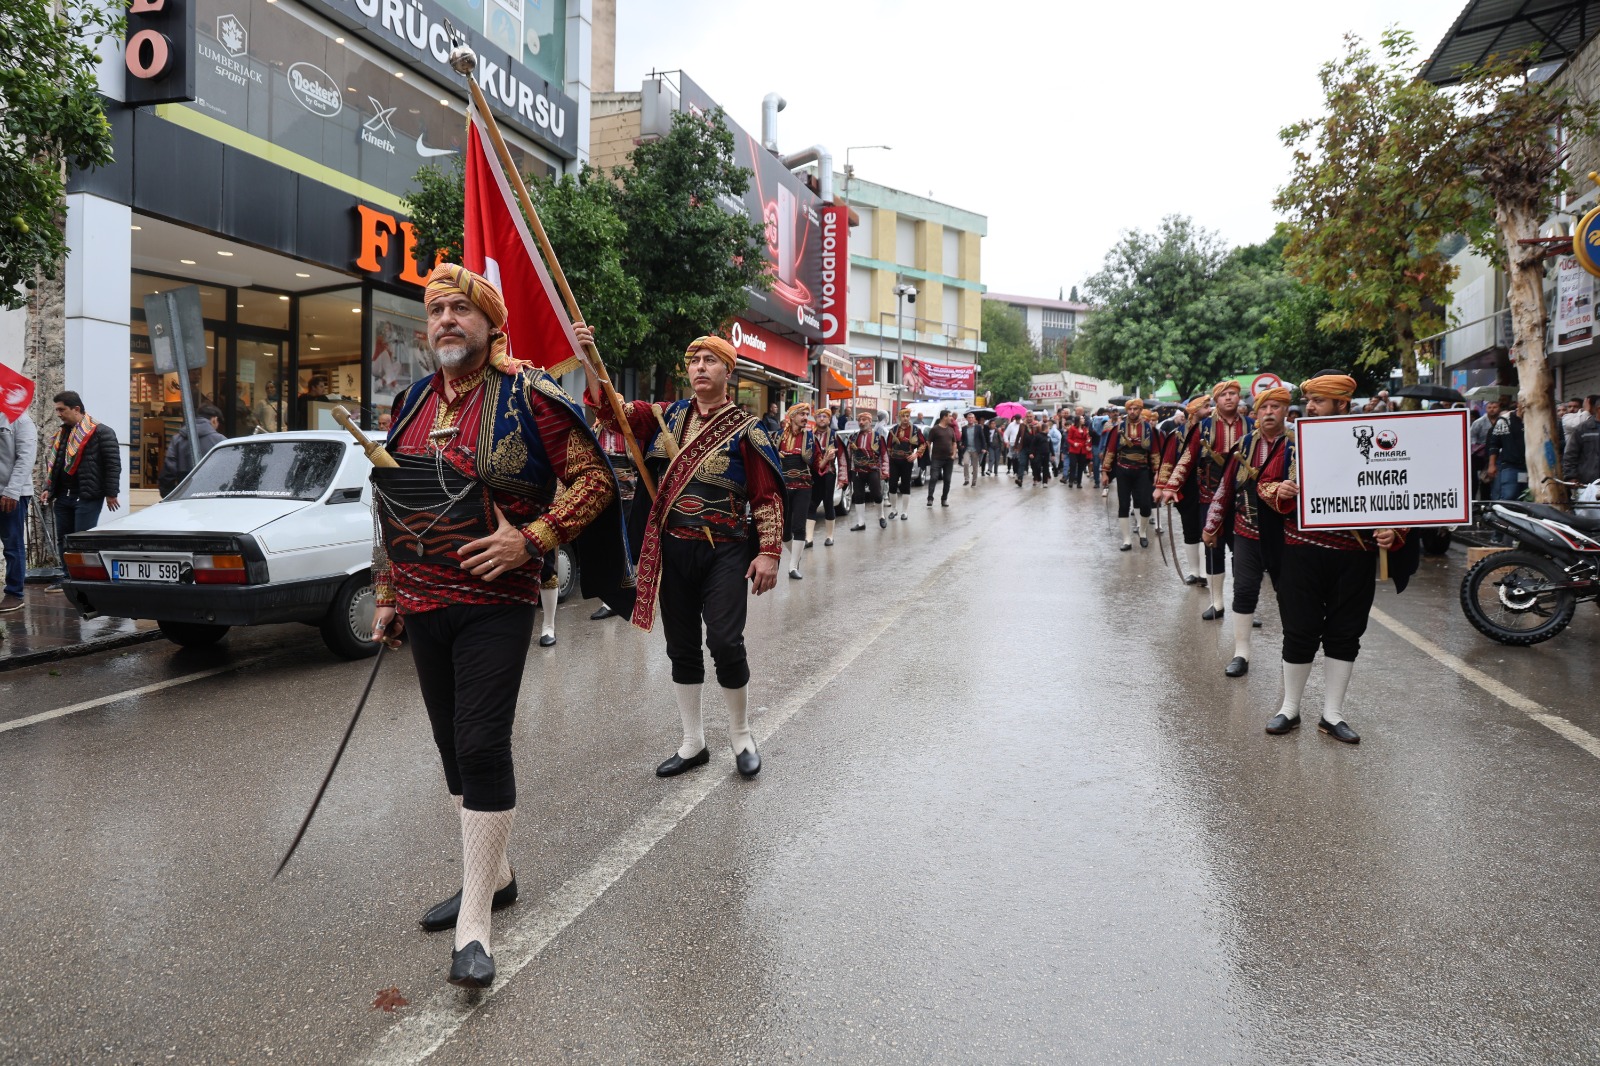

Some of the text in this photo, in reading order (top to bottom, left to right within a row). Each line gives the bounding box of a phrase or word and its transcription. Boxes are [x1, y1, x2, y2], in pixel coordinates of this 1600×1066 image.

[198, 44, 263, 84] LUMBERJACK
[214, 65, 248, 88] SPORT
[479, 54, 565, 138] KURSU
[361, 128, 395, 154] kinetix
[822, 212, 837, 309] vodafone
[742, 332, 767, 352] vodafone
[1374, 450, 1407, 458] ANKARA
[1357, 469, 1408, 487] ANKARA
[1310, 487, 1458, 515] SEYMENLER KULÜBÜ DERNEĞİ
[118, 563, 178, 579] 01 RU 598
